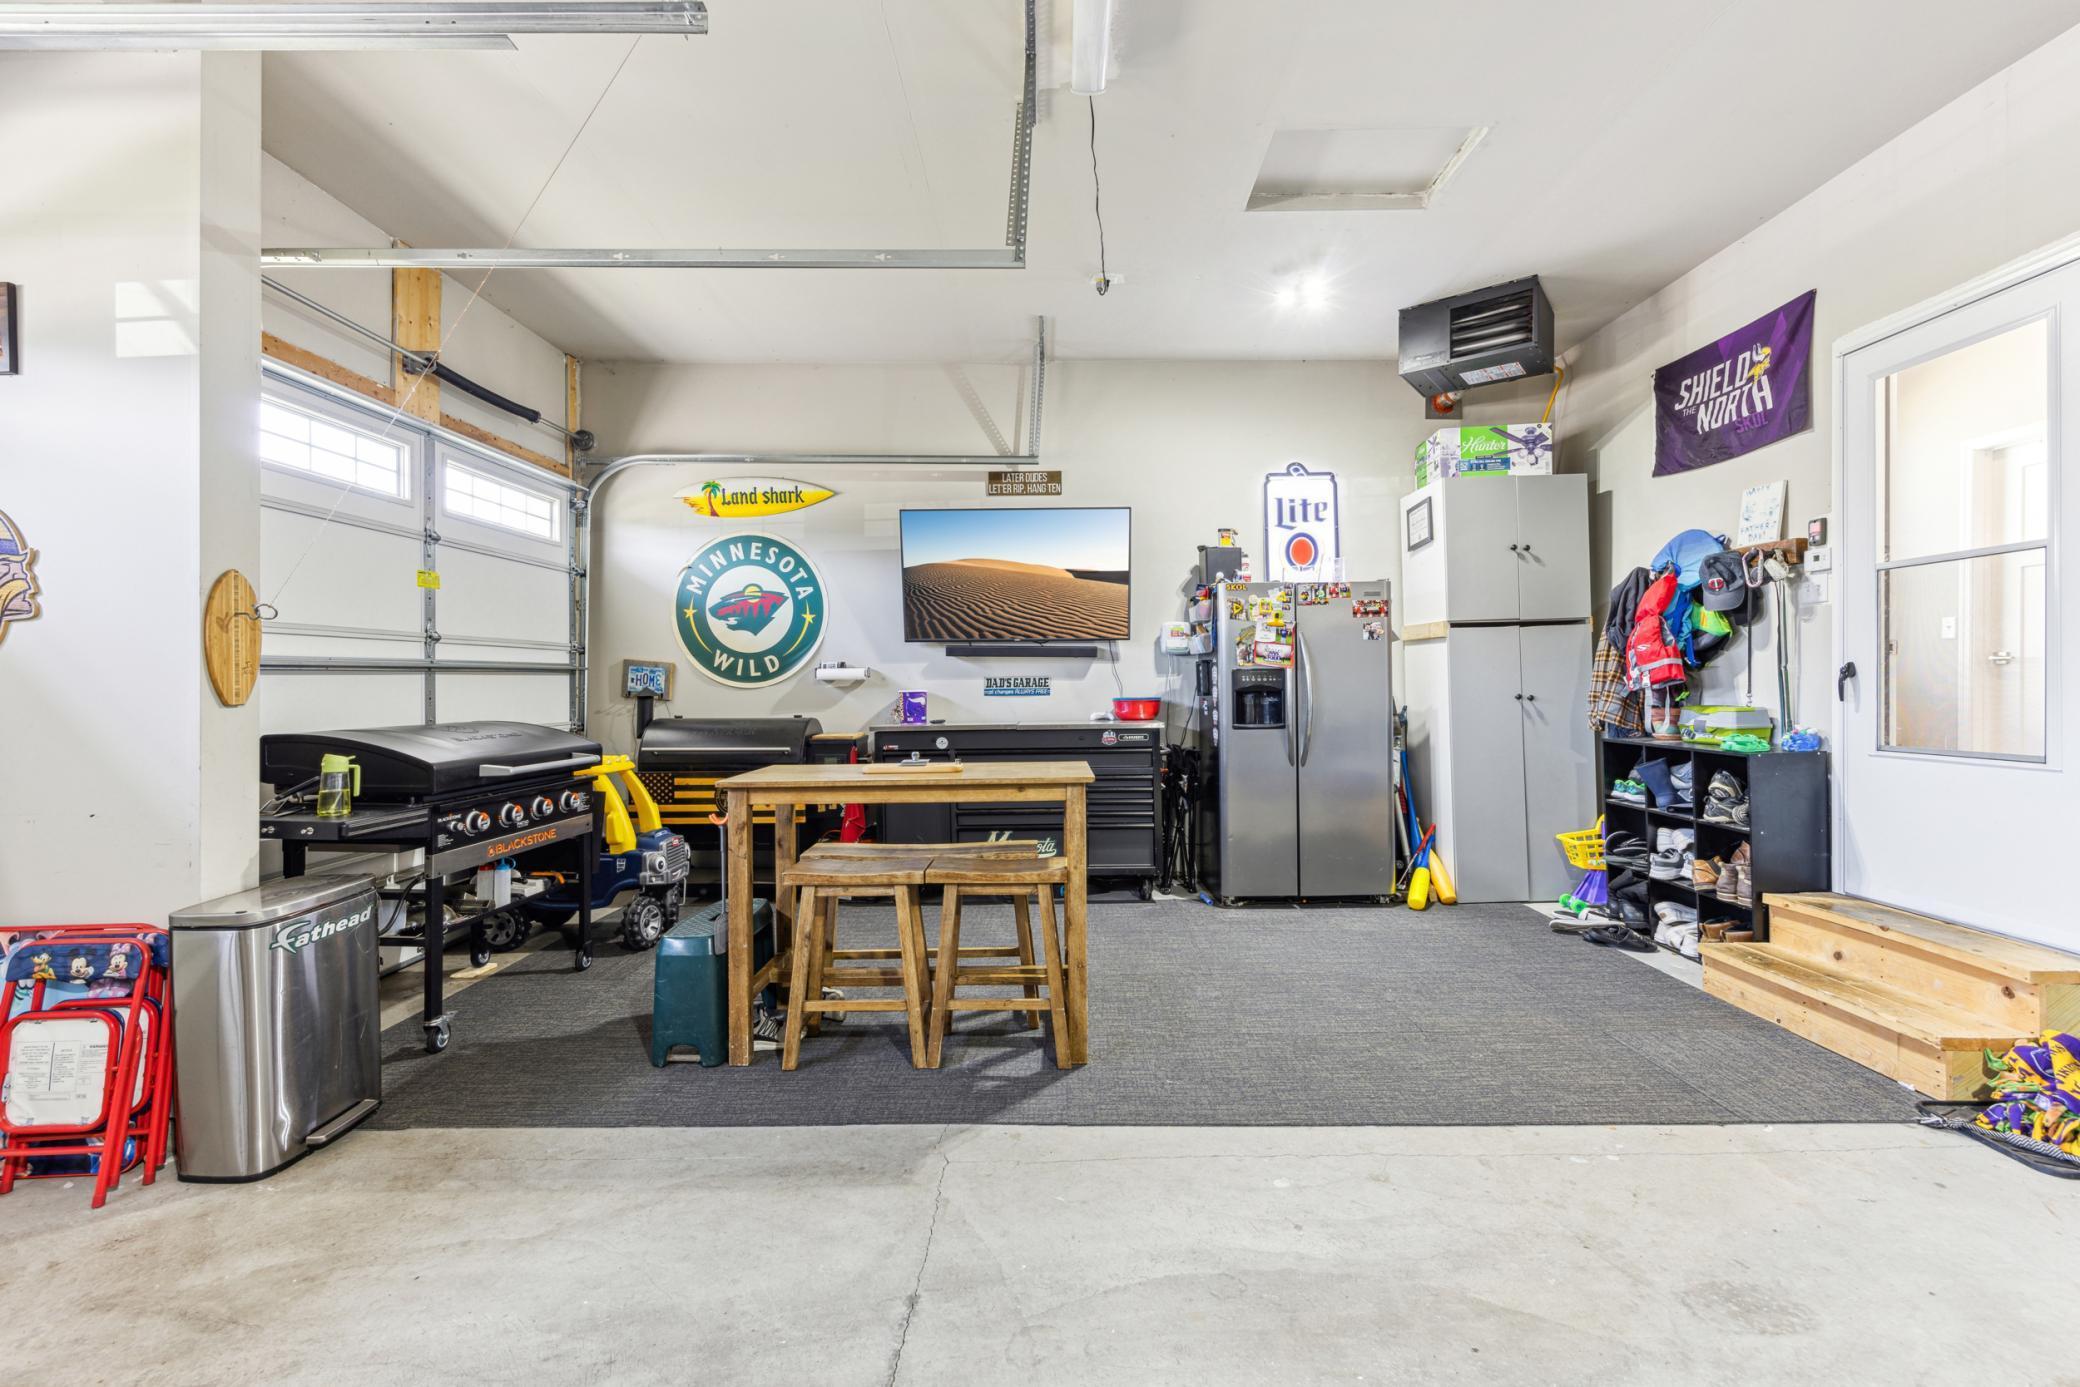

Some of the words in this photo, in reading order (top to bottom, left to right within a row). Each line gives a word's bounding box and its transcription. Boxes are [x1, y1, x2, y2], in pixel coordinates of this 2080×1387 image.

[1674, 351, 1751, 411] SHIELD
[1683, 406, 1697, 417] THE
[1696, 374, 1773, 435] NORTH
[1462, 435, 1507, 454] Hunter
[1001, 472, 1024, 483] LATER
[1025, 472, 1048, 483] DUDES
[1027, 483, 1047, 493] HANG
[1047, 483, 1061, 493] TEN
[721, 487, 758, 506] Land
[762, 485, 805, 505] shark
[1274, 497, 1328, 531] Lite
[686, 541, 814, 600] MINNESOTA
[1226, 583, 1247, 591] SKOL
[713, 650, 781, 677] WILD
[985, 677, 1012, 688] DAD'S
[1013, 677, 1049, 688] GARAGE
[495, 829, 557, 855] BLACKSTONE
[270, 904, 373, 954] Fathead
